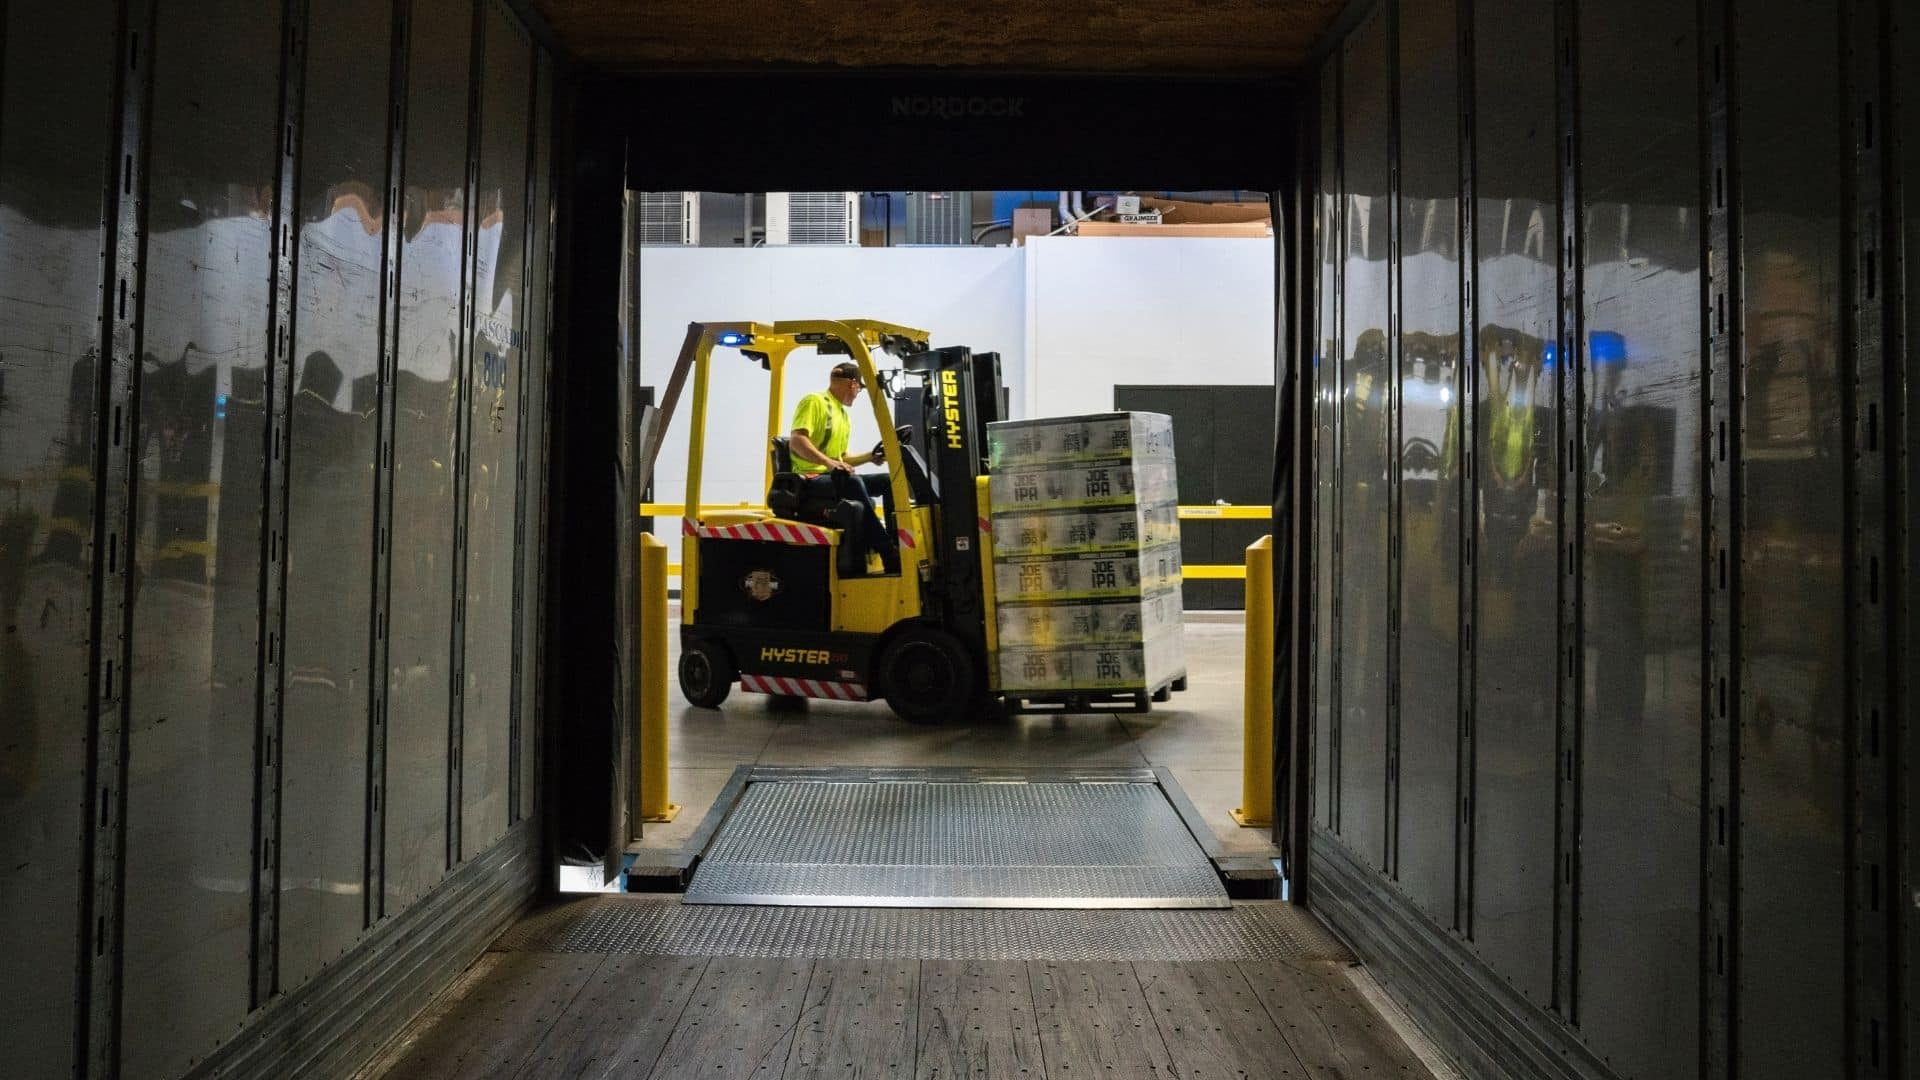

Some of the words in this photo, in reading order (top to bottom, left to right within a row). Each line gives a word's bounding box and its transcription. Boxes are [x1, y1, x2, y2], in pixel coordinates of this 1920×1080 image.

[891, 96, 1025, 117] NORDOCK
[942, 370, 961, 448] HYSTER
[1015, 475, 1037, 486] JOE
[1086, 470, 1109, 481] JOE
[1015, 487, 1038, 501] IPA
[1086, 481, 1110, 497] IPA
[1120, 522, 1135, 531] JOE
[1118, 530, 1135, 542] IPA
[1019, 565, 1041, 576] JOE
[1092, 561, 1115, 573] JOE
[1019, 577, 1042, 592] IPA
[1092, 573, 1116, 588] IPA
[761, 647, 830, 665] HYSTER
[1024, 654, 1046, 665] JOE
[1096, 652, 1120, 664] JOE
[1024, 666, 1047, 681] IPA
[1096, 665, 1121, 679] IPA
